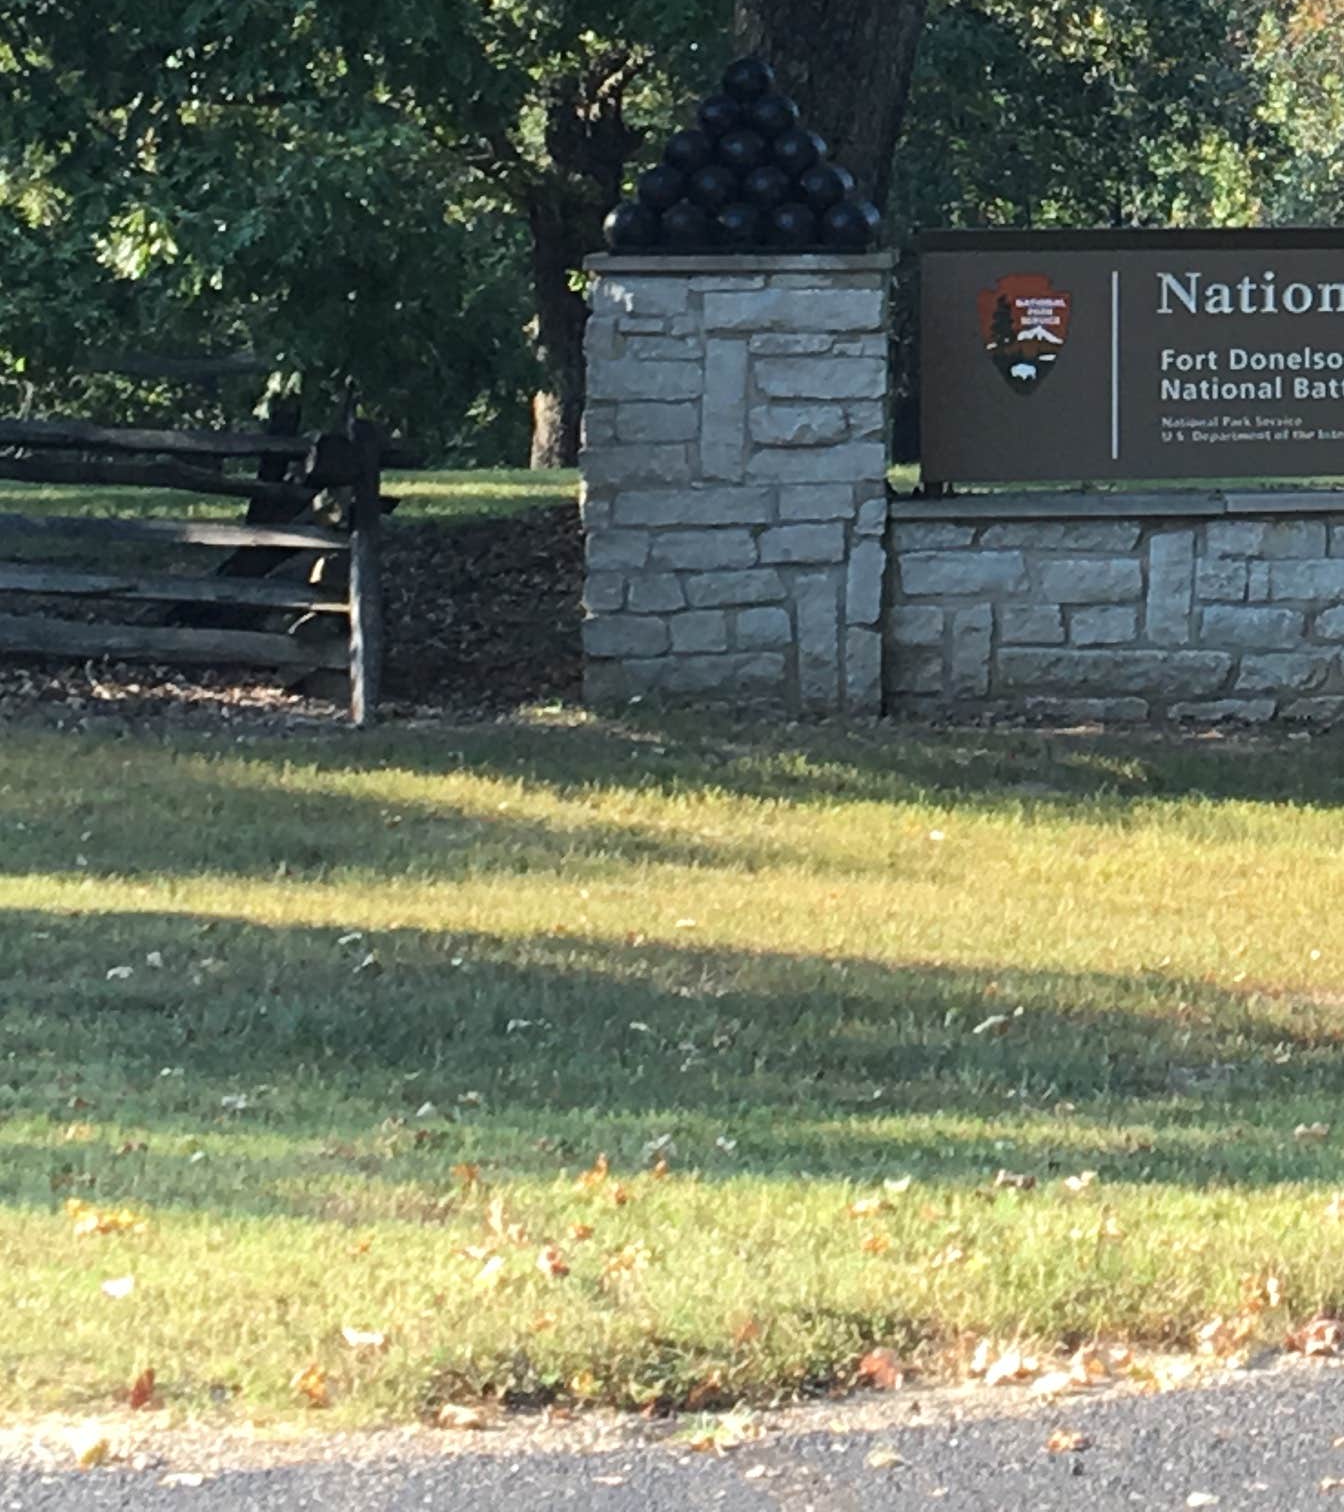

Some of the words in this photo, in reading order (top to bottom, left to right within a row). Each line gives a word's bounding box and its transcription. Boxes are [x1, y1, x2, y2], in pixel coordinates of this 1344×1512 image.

[1161, 349, 1218, 372] Fort
[1160, 376, 1283, 401] National
[1161, 416, 1219, 428] National
[1222, 416, 1251, 427] Park
[1255, 415, 1303, 427] Service
[1192, 430, 1271, 443] Department
[1274, 429, 1289, 440] of
[1292, 429, 1315, 440] the
